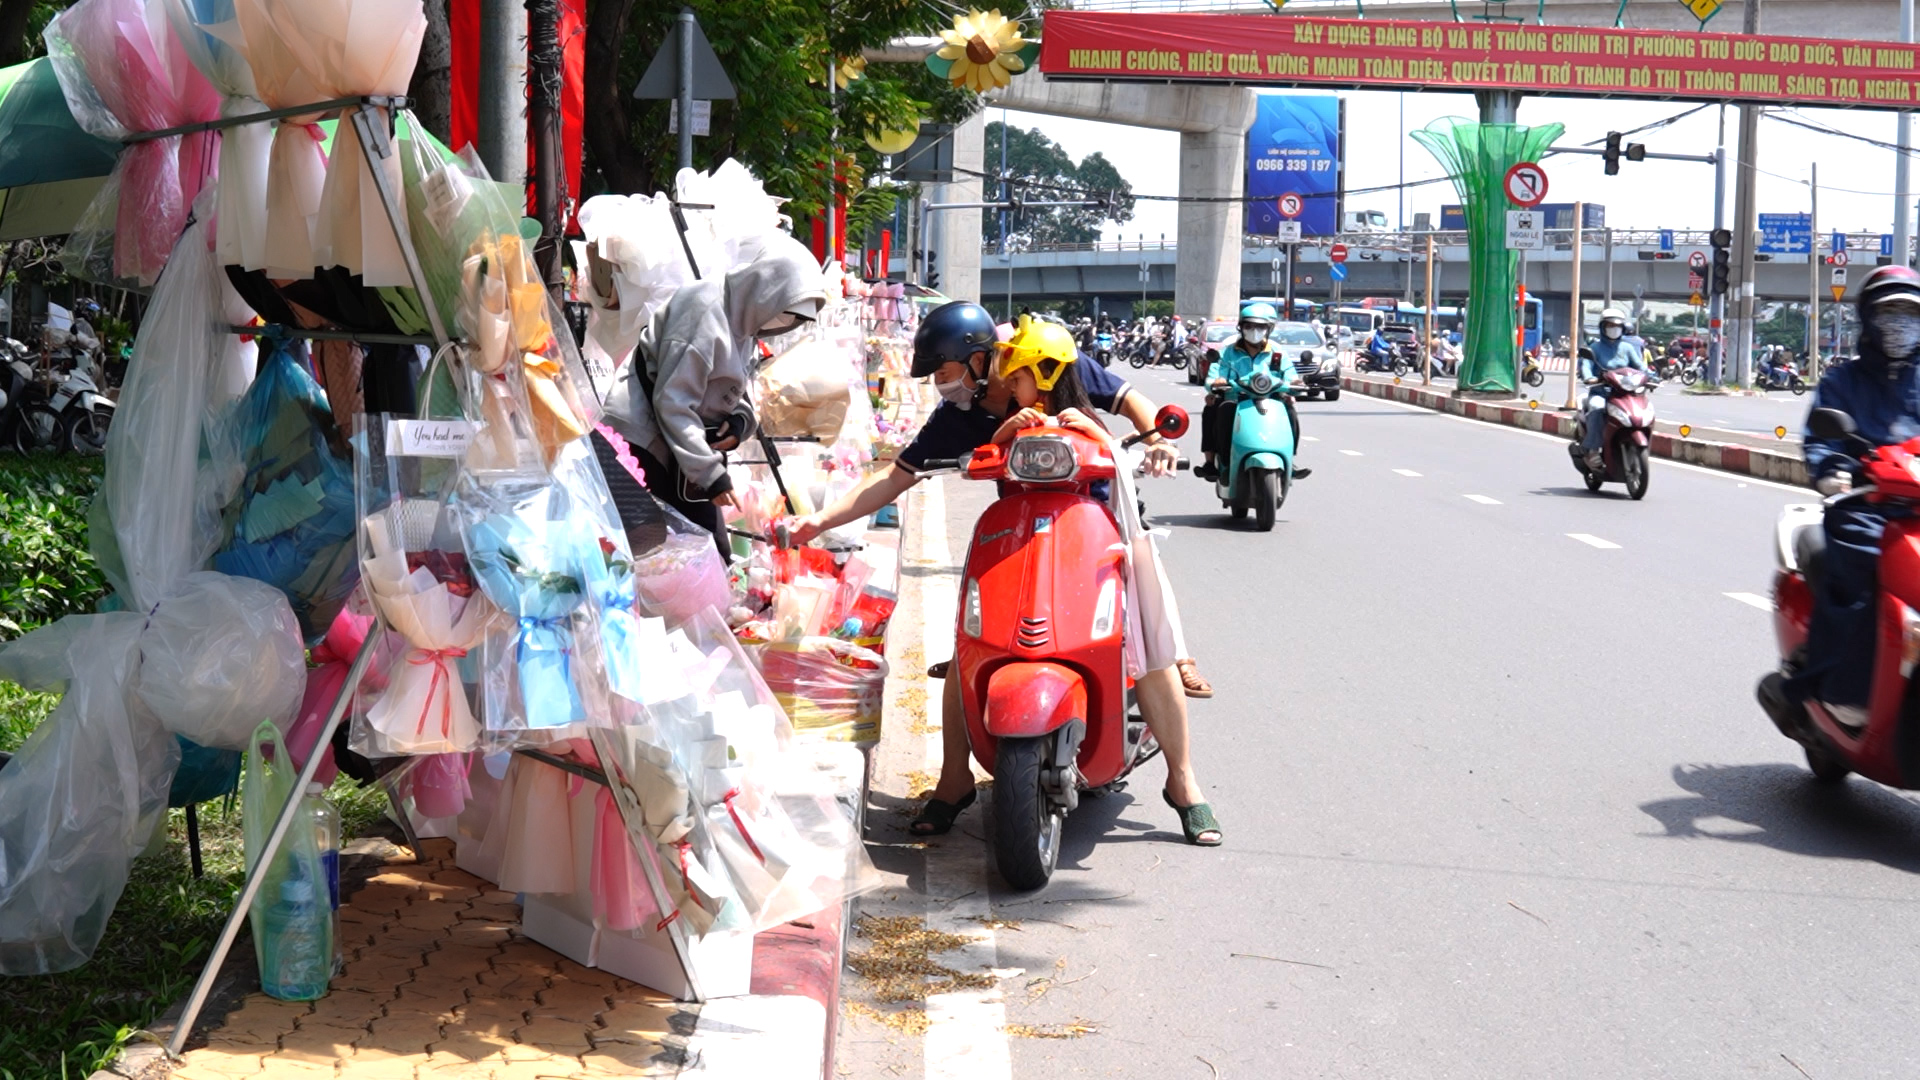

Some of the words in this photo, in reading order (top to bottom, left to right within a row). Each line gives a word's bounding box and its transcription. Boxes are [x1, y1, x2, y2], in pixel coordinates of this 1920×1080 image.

[1294, 21, 1323, 44] XÂY
[1328, 23, 1370, 48] DỰNG
[1375, 23, 1417, 47] ĐẢNG
[1422, 26, 1443, 51] BỘ
[1448, 27, 1468, 49] VÀ
[1472, 28, 1492, 53] HỆ
[1496, 26, 1547, 52] THỐNG
[1551, 31, 1600, 54] CHÍNH
[1604, 35, 1629, 58] TRỊ
[1634, 34, 1695, 58] PHƯỜNG
[1700, 36, 1729, 60] THỦ
[1734, 38, 1765, 61] ĐỨC
[1770, 43, 1800, 66] ĐẠO
[1804, 43, 1838, 67] ĐỨC,
[1842, 45, 1871, 67] VĂN
[1876, 49, 1914, 69] MINH
[1069, 49, 1121, 69] NHANH
[1127, 48, 1183, 72] CHÓNG,
[1188, 49, 1223, 76] HIỆU
[1228, 50, 1262, 75] QUẢ,
[1267, 52, 1309, 75] VỮNG
[1314, 57, 1359, 80] MẠNH
[1364, 56, 1403, 79] TOÀN
[1452, 56, 1499, 82] QUYẾT
[1503, 60, 1536, 83] TÂM
[1541, 61, 1571, 84] TRỞ
[1575, 64, 1625, 86] THÀNH
[1656, 69, 1680, 92] THỊ
[1685, 68, 1735, 91] THÔNG
[1739, 73, 1782, 95] MINH,
[1786, 73, 1826, 96] SÁNG
[1830, 78, 1860, 101] TẠO,
[1865, 78, 1910, 100] NGHĨA
[1256, 159, 1284, 171] 0966
[1286, 159, 1307, 171] 339
[1311, 159, 1331, 172] 197
[414, 425, 431, 446] You
[432, 425, 450, 441] had
